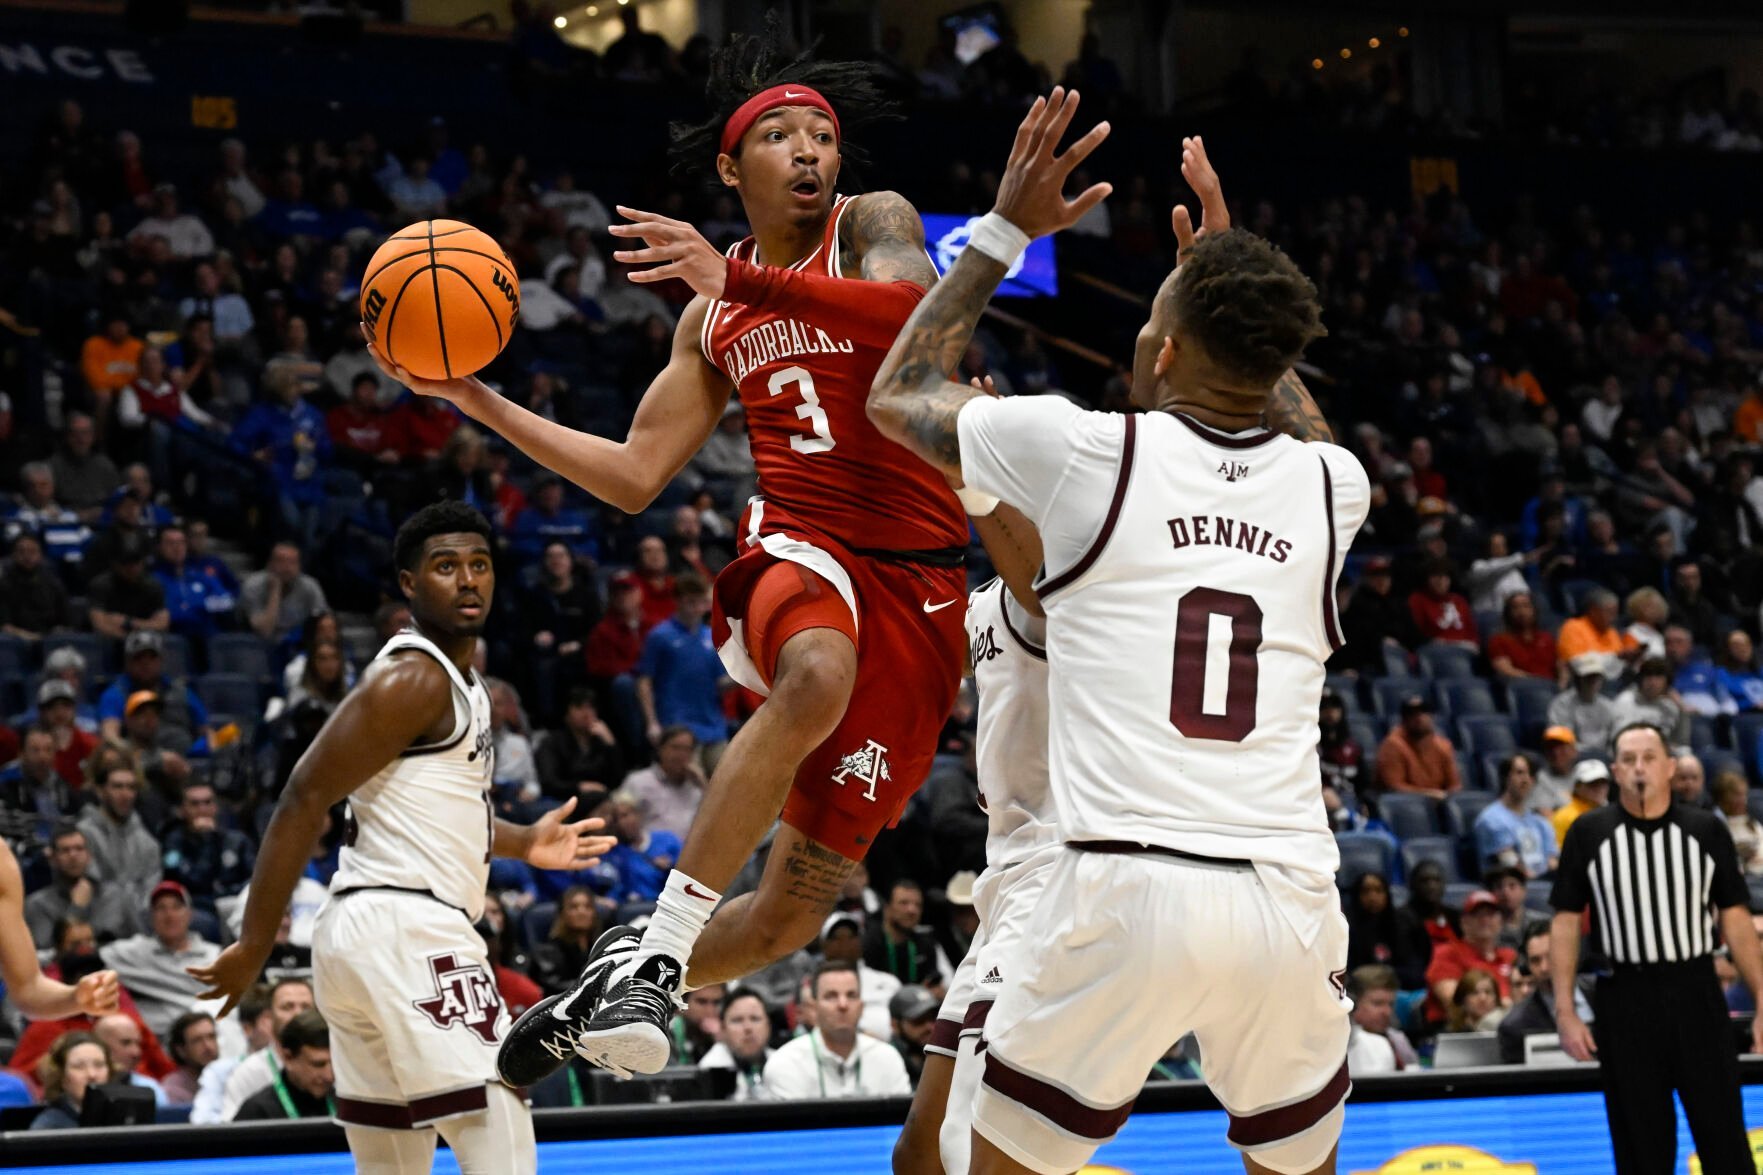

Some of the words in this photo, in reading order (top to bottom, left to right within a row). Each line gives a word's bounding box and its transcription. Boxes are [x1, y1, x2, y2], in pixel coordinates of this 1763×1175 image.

[767, 365, 836, 455] 3
[1166, 515, 1293, 563] DENNIS
[1169, 586, 1264, 743] 0
